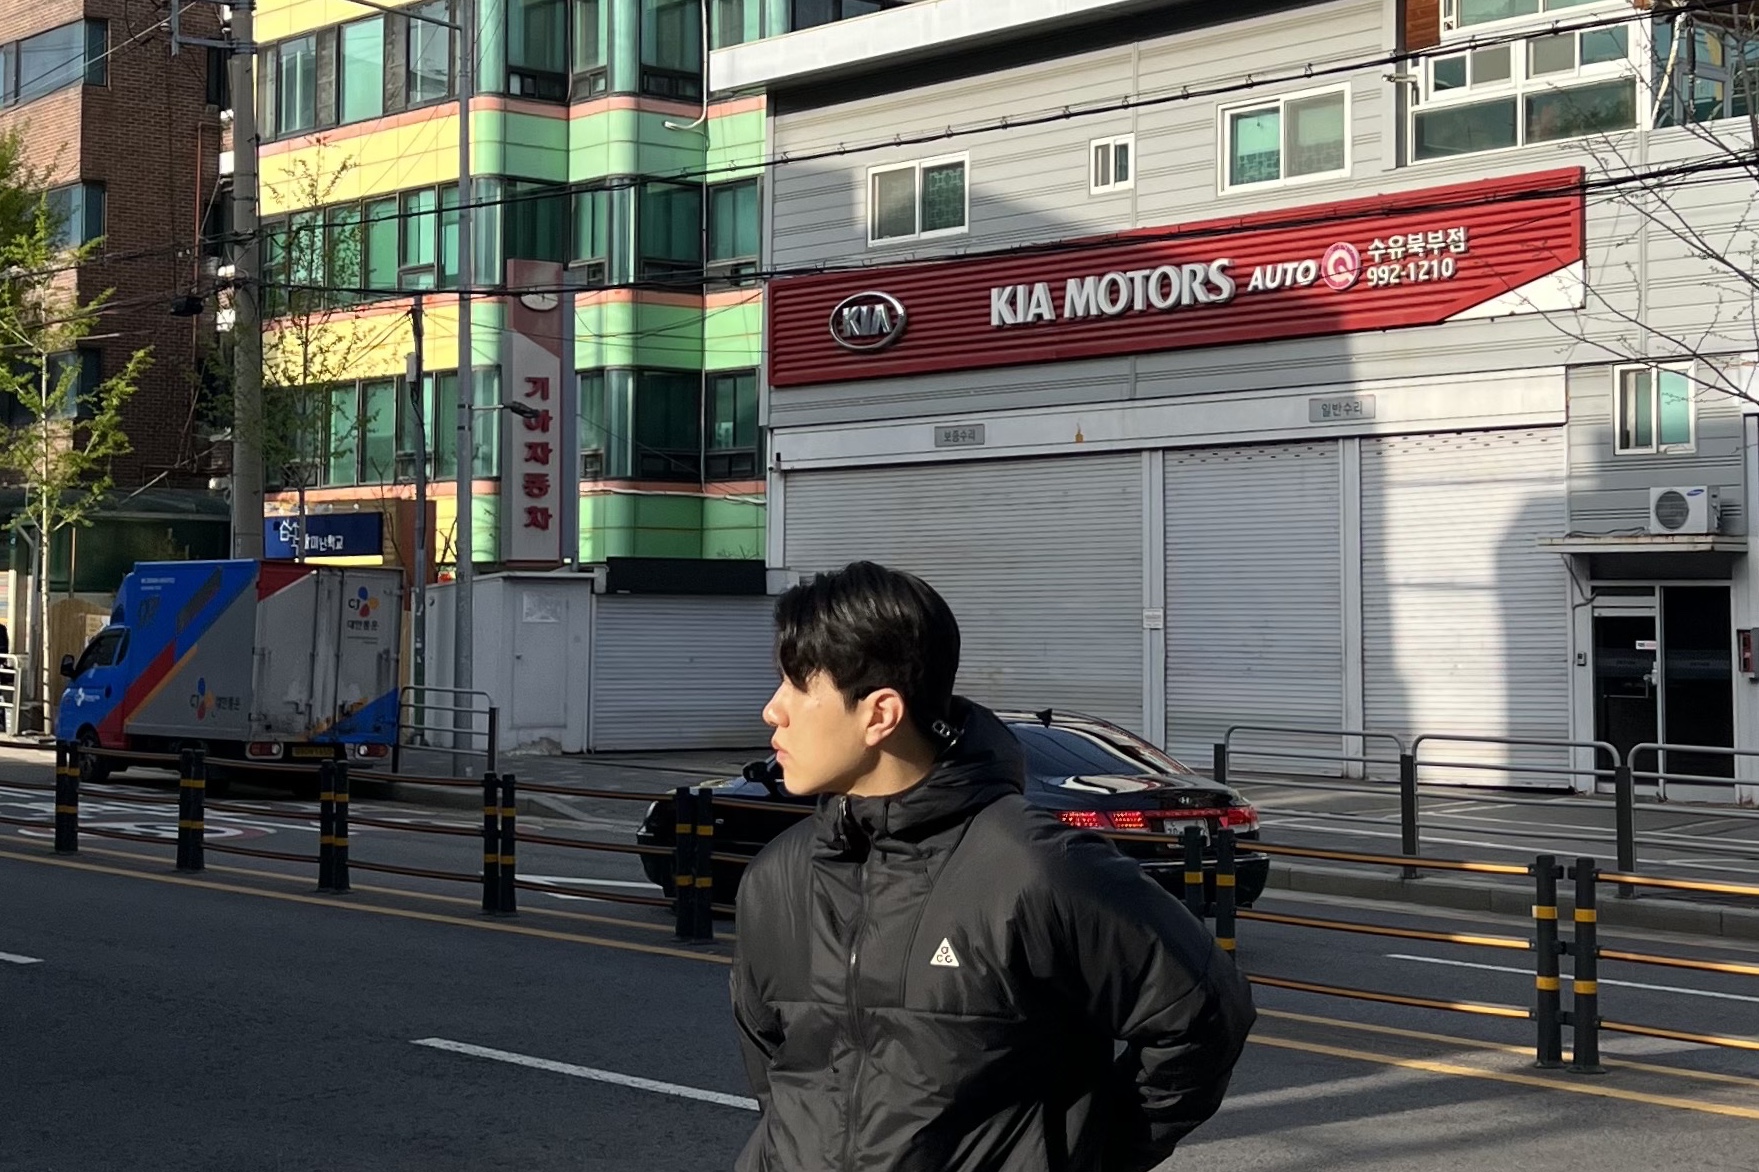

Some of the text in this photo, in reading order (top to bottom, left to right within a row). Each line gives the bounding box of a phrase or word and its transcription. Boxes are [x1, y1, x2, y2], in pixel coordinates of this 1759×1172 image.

[1367, 226, 1468, 262] 수유북부점
[1366, 257, 1457, 287] 992-1210
[990, 282, 1056, 326] KIA
[1063, 258, 1236, 319] MOTORS
[1247, 259, 1319, 291] AUTO
[841, 304, 892, 337] KIA
[1321, 401, 1363, 417] 일반수리
